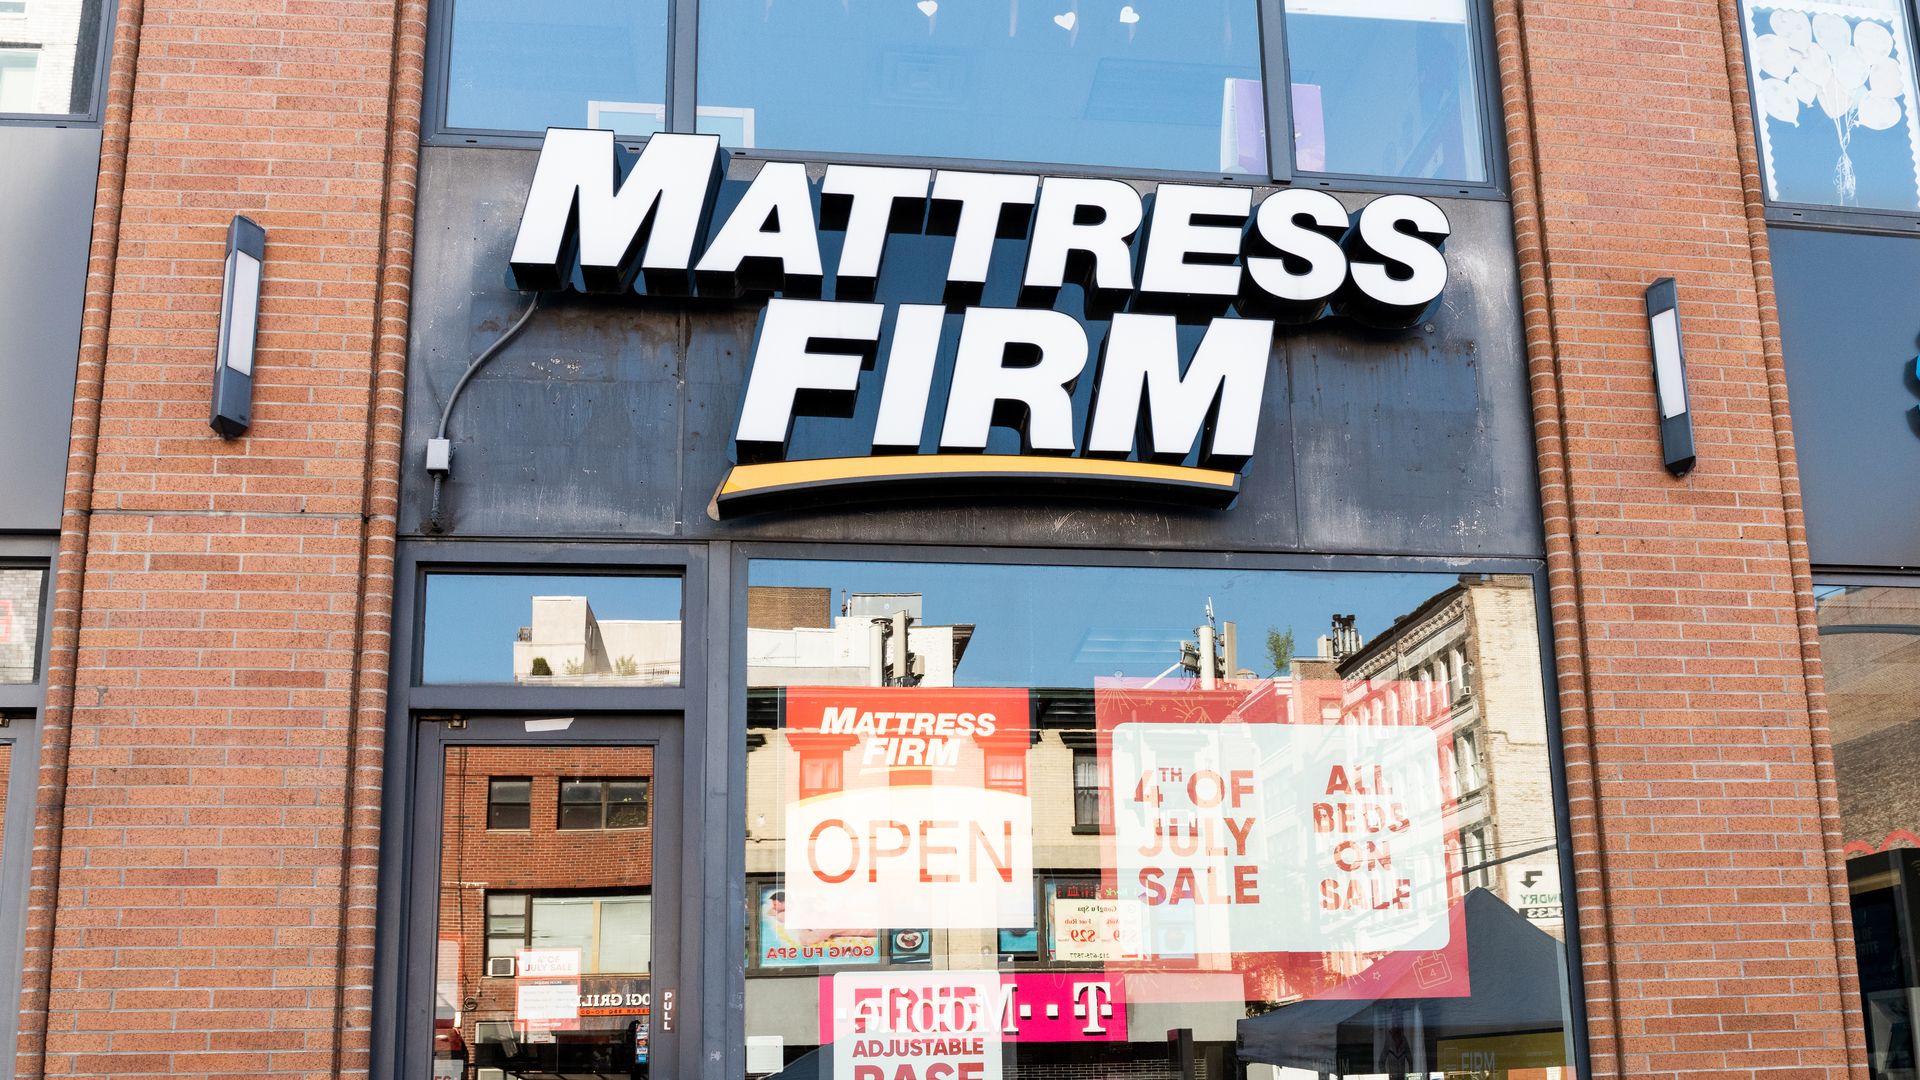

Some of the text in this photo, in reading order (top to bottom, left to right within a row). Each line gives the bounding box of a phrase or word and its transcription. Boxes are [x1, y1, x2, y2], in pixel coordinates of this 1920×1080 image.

[509, 127, 1450, 307] MATTRESS
[735, 297, 1275, 457] FIRM
[819, 706, 997, 737] MATTRESS
[861, 737, 962, 766] FIRM
[1133, 767, 1255, 809] 4TH OF
[1325, 764, 1393, 796] ALL
[1312, 802, 1411, 833] BEDS
[807, 818, 1013, 884] OPEN
[1137, 817, 1257, 858] JULY
[1333, 840, 1392, 873] ON
[1137, 865, 1260, 907] SALE
[1319, 878, 1412, 911] SALE
[663, 991, 673, 1031] PULL
[852, 1037, 985, 1058] ADJUSTABLE
